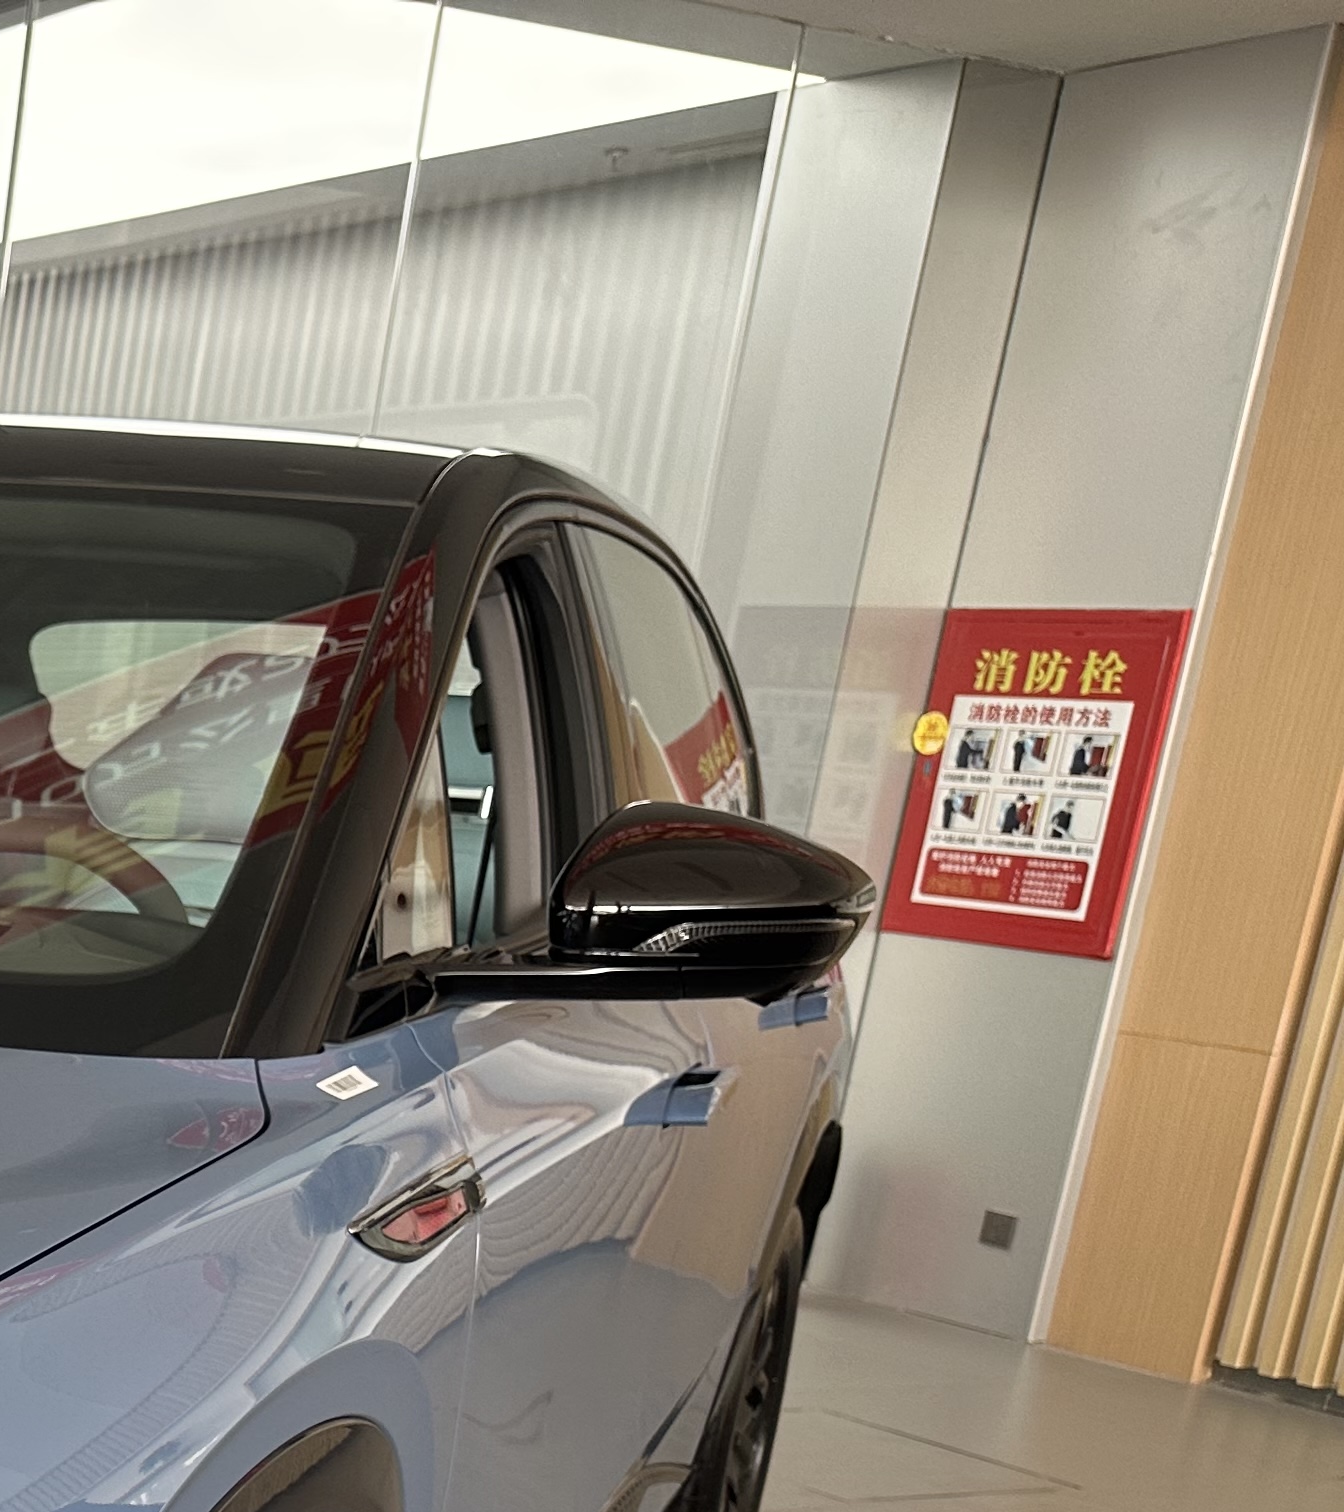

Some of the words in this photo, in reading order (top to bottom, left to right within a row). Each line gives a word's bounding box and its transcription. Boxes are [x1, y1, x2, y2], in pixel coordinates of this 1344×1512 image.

[973, 647, 1128, 697] 消防栓
[967, 702, 1113, 728] 消防栓的使用方法
